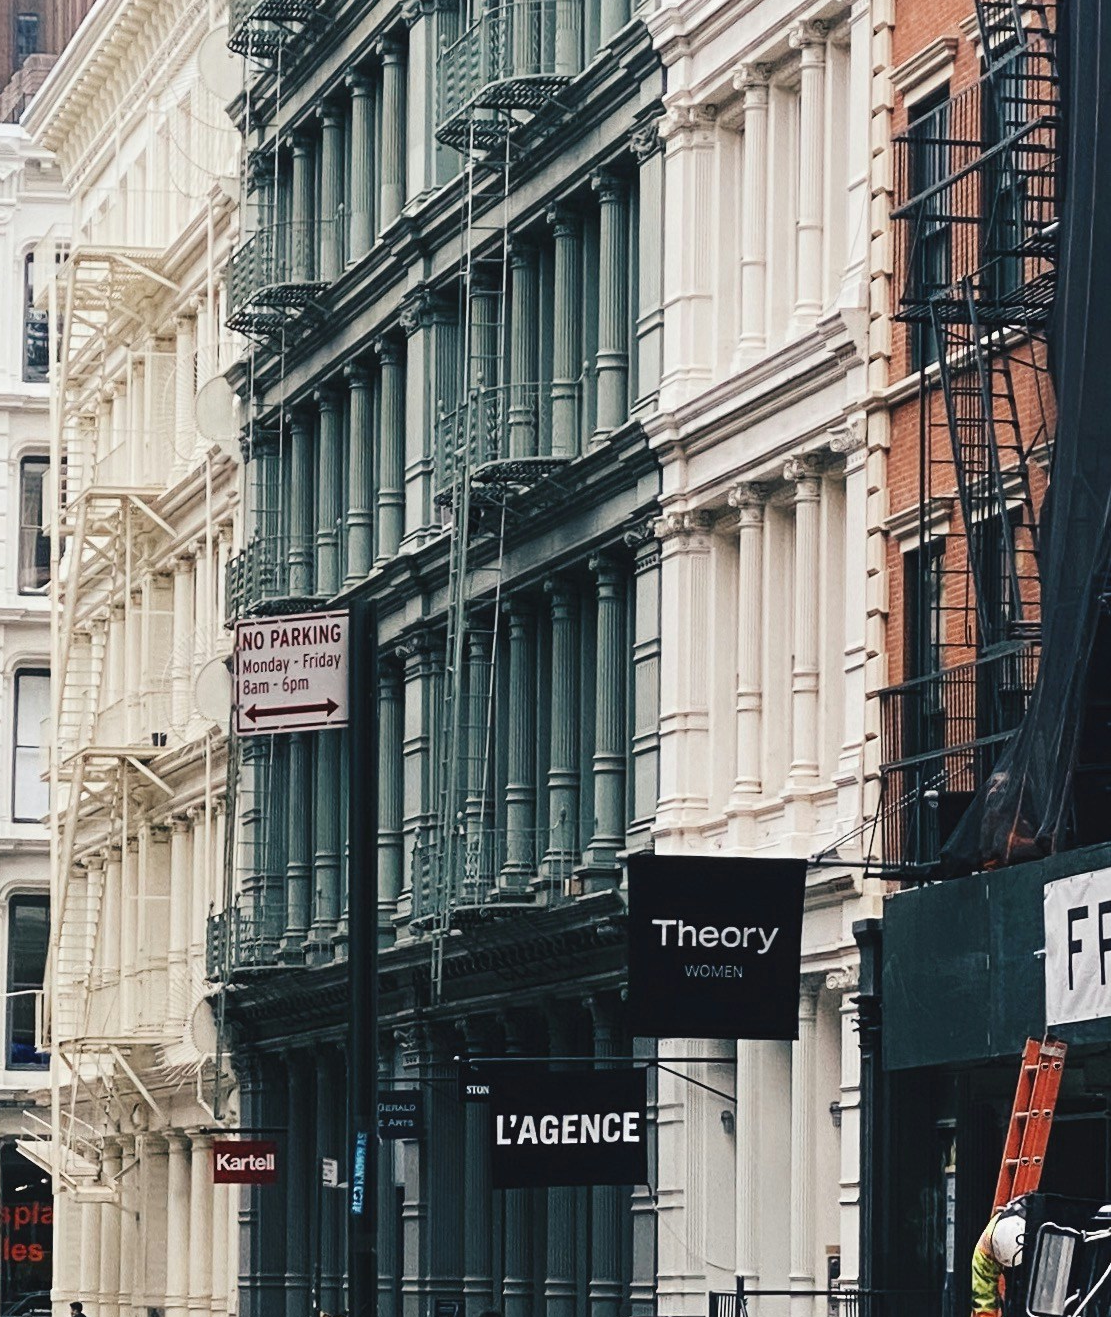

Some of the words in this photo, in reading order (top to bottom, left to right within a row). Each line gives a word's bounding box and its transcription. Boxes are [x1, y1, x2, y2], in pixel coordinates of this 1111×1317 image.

[242, 631, 264, 651] NO
[270, 623, 342, 649] PARKING
[242, 656, 290, 675] Monday
[303, 652, 342, 670] Friday
[242, 679, 270, 696] 8am
[282, 676, 309, 694] 6pm
[651, 919, 780, 955] Theory
[684, 963, 743, 979] WOMEN
[495, 1111, 640, 1146] L'AGENCE
[215, 1153, 275, 1171] Kartell
